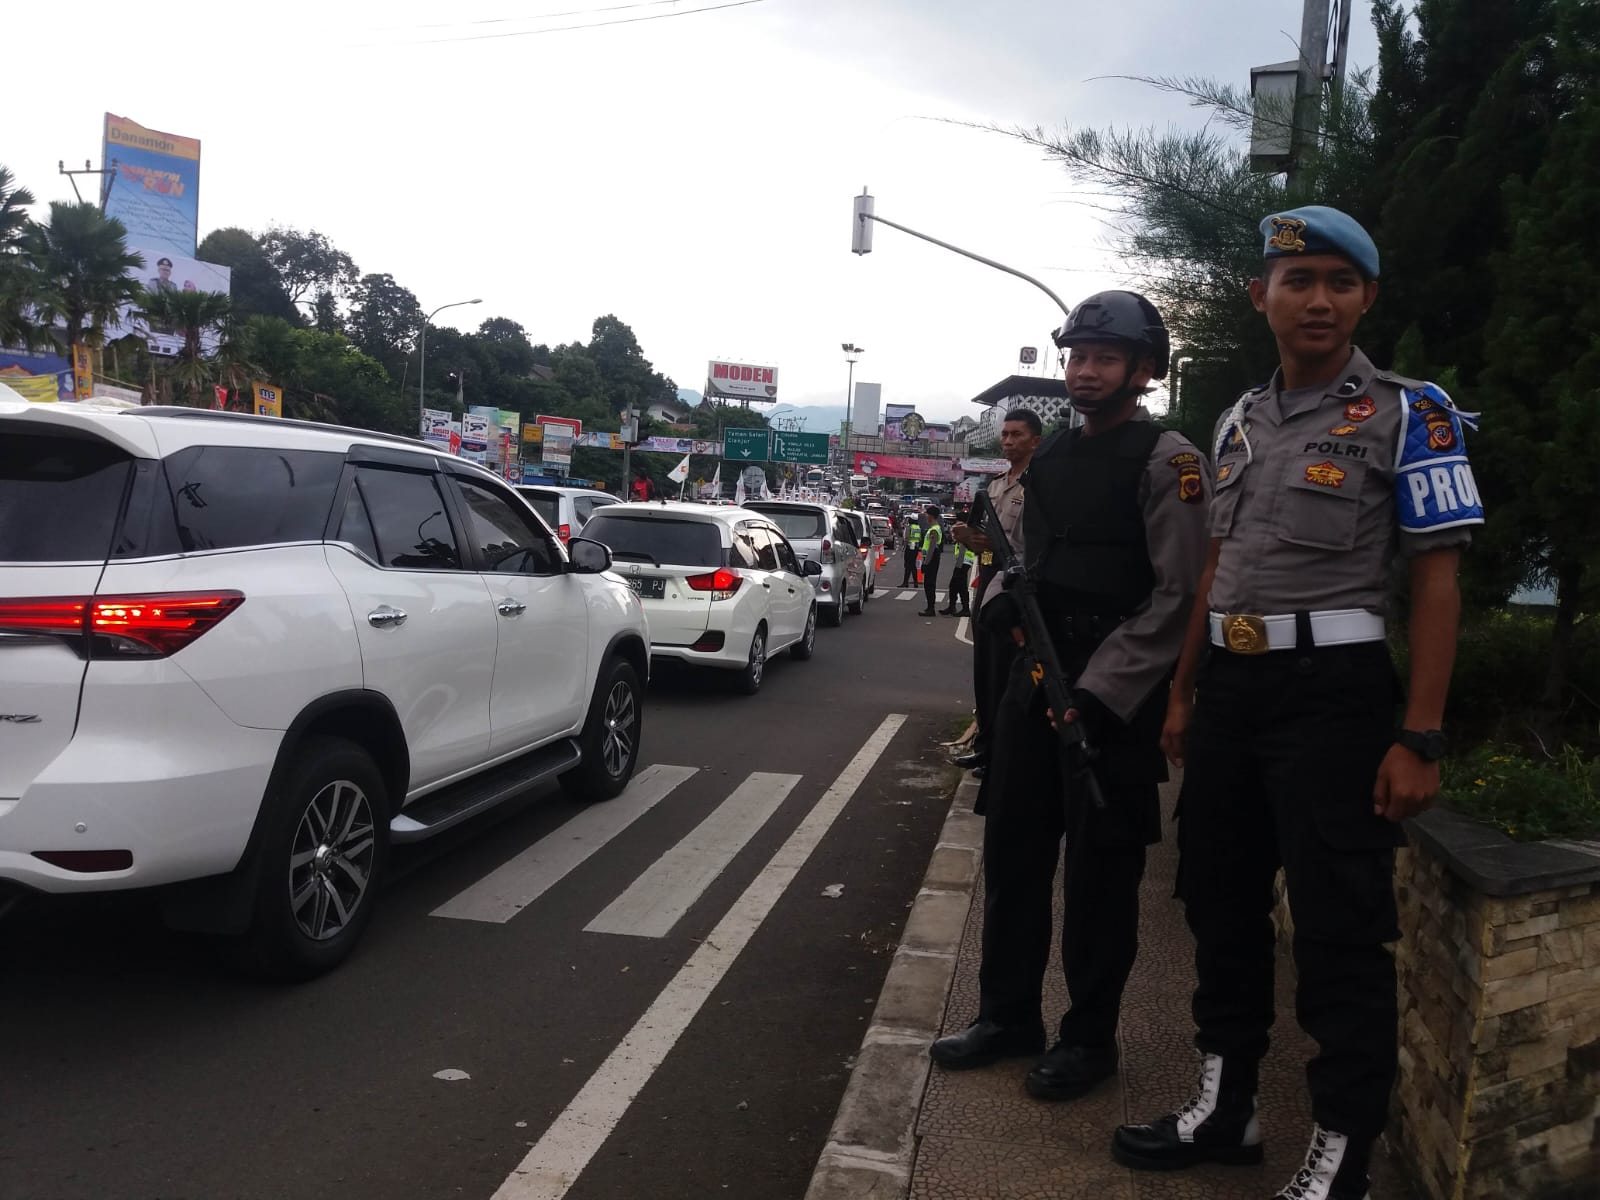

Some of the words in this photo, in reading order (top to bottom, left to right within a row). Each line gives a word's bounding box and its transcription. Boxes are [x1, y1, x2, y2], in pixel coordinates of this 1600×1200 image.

[713, 363, 774, 384] MODEN
[1303, 441, 1368, 459] POLRI
[652, 580, 664, 591] PJ
